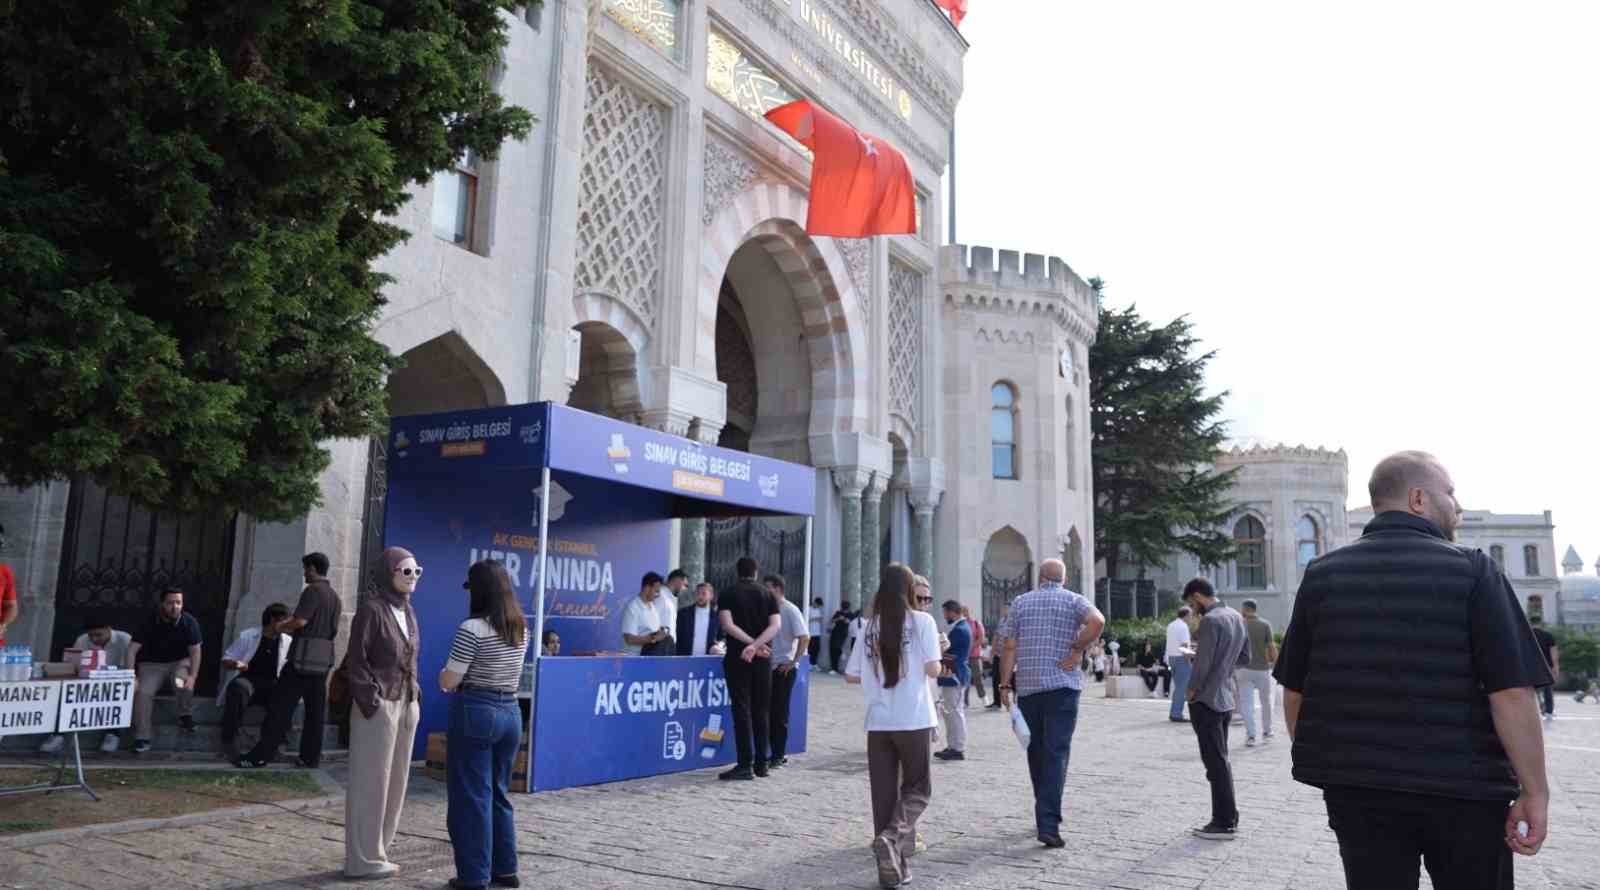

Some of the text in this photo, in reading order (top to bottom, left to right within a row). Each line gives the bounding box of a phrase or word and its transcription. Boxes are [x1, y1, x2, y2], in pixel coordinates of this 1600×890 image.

[419, 428, 446, 443] SINAV
[446, 422, 471, 441] GİRİŞ
[472, 417, 512, 438] BELGESİ
[644, 441, 751, 481] SINAV GİRİŞ BELGESİ
[65, 682, 131, 704] EMANET
[594, 671, 731, 717] AK GENÇLİK İST
